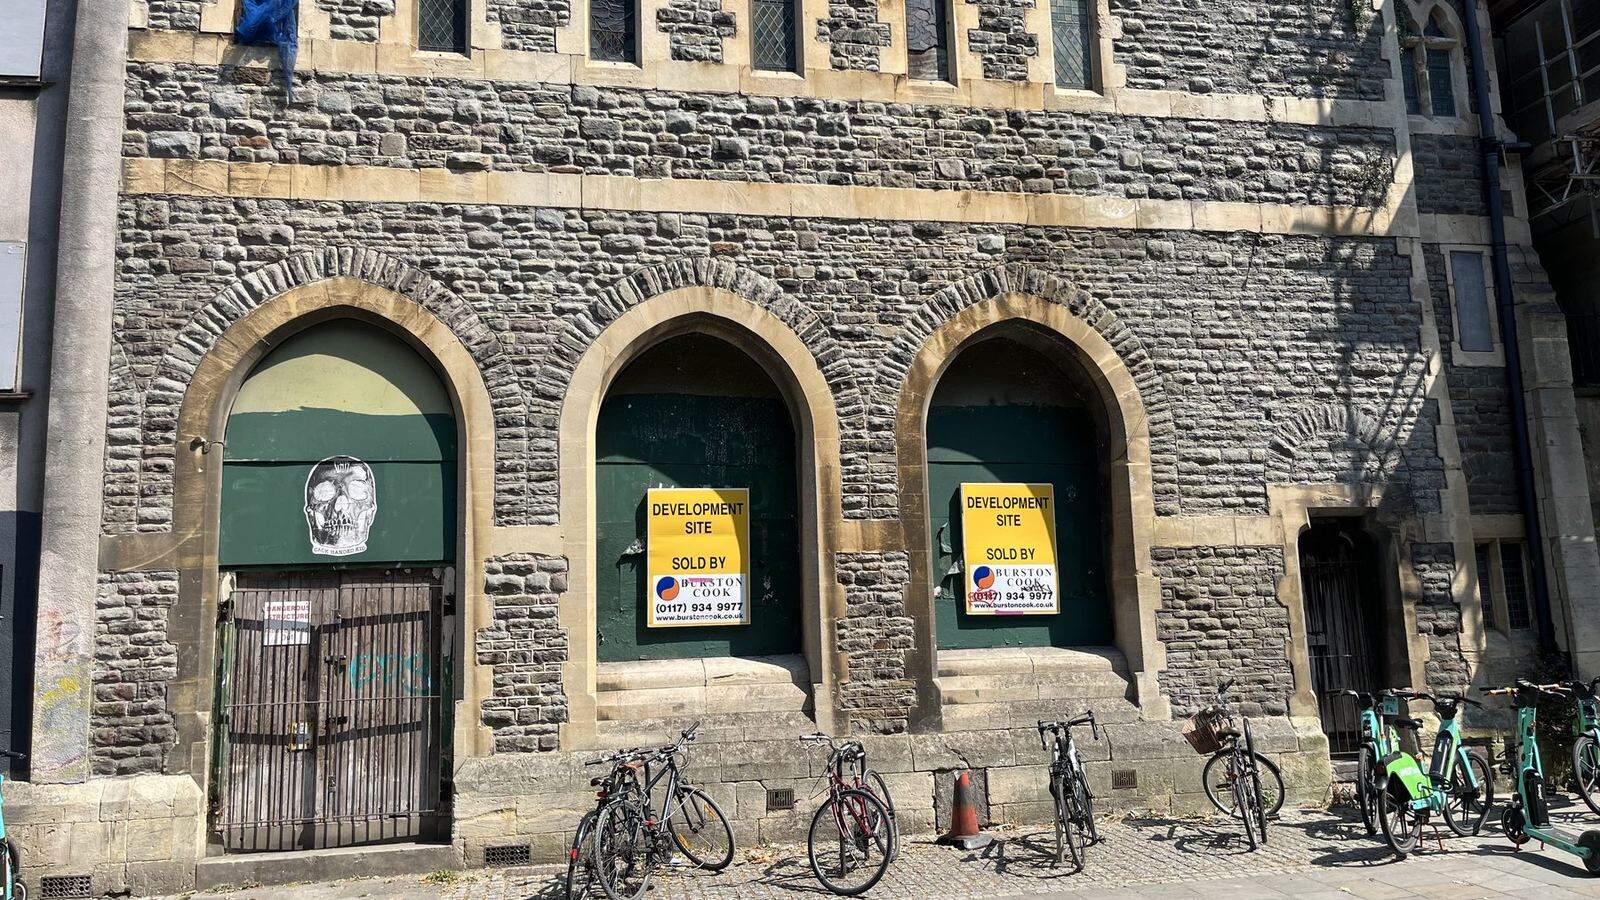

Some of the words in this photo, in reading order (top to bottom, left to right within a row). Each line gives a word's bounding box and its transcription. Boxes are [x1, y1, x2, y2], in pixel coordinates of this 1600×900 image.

[967, 496, 1050, 509] DEVELOPMENT
[653, 502, 744, 516] DEVELOPMENT
[996, 514, 1022, 527] SITE
[685, 521, 712, 534] SITE
[986, 548, 1017, 560] SOLD
[1020, 547, 1036, 560] BY
[672, 557, 706, 570] SOLD
[710, 556, 726, 569] BY
[996, 568, 1052, 577] BURSTON
[681, 577, 744, 588] BURSTON
[1006, 577, 1041, 587] COOK
[693, 588, 731, 598] COOK
[1005, 591, 1025, 601] 934
[1029, 591, 1053, 601] 9977
[656, 604, 687, 613] (0117)
[691, 602, 712, 612] 934
[717, 602, 743, 611] 9977
[656, 613, 744, 621] www.burstoncook.co.uk
